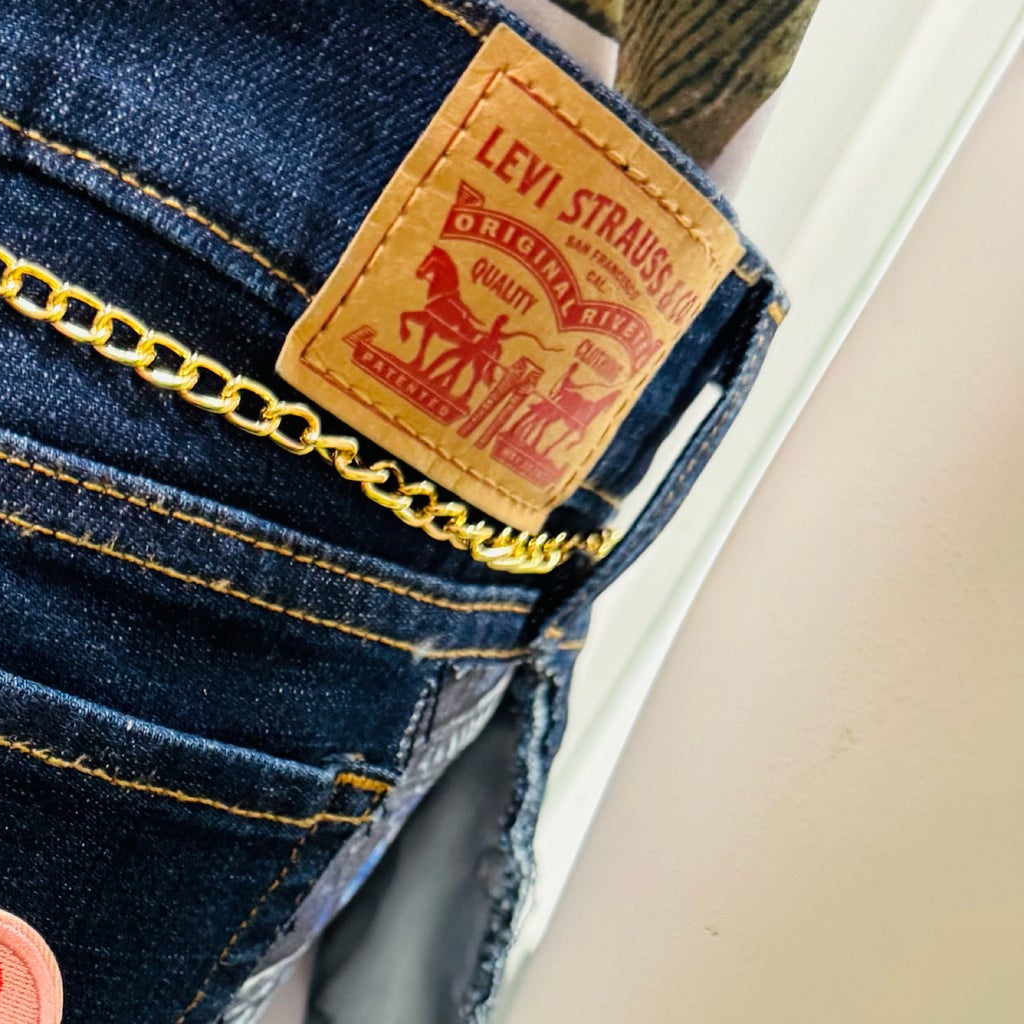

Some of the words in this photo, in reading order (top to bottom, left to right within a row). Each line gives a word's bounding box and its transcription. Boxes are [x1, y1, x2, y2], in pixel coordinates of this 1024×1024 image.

[474, 125, 563, 209] LEVI
[557, 188, 674, 296] STRAUSS
[454, 213, 576, 318] ORIGINAL
[471, 257, 538, 315] QUALITY
[362, 351, 449, 416] PATENTED
